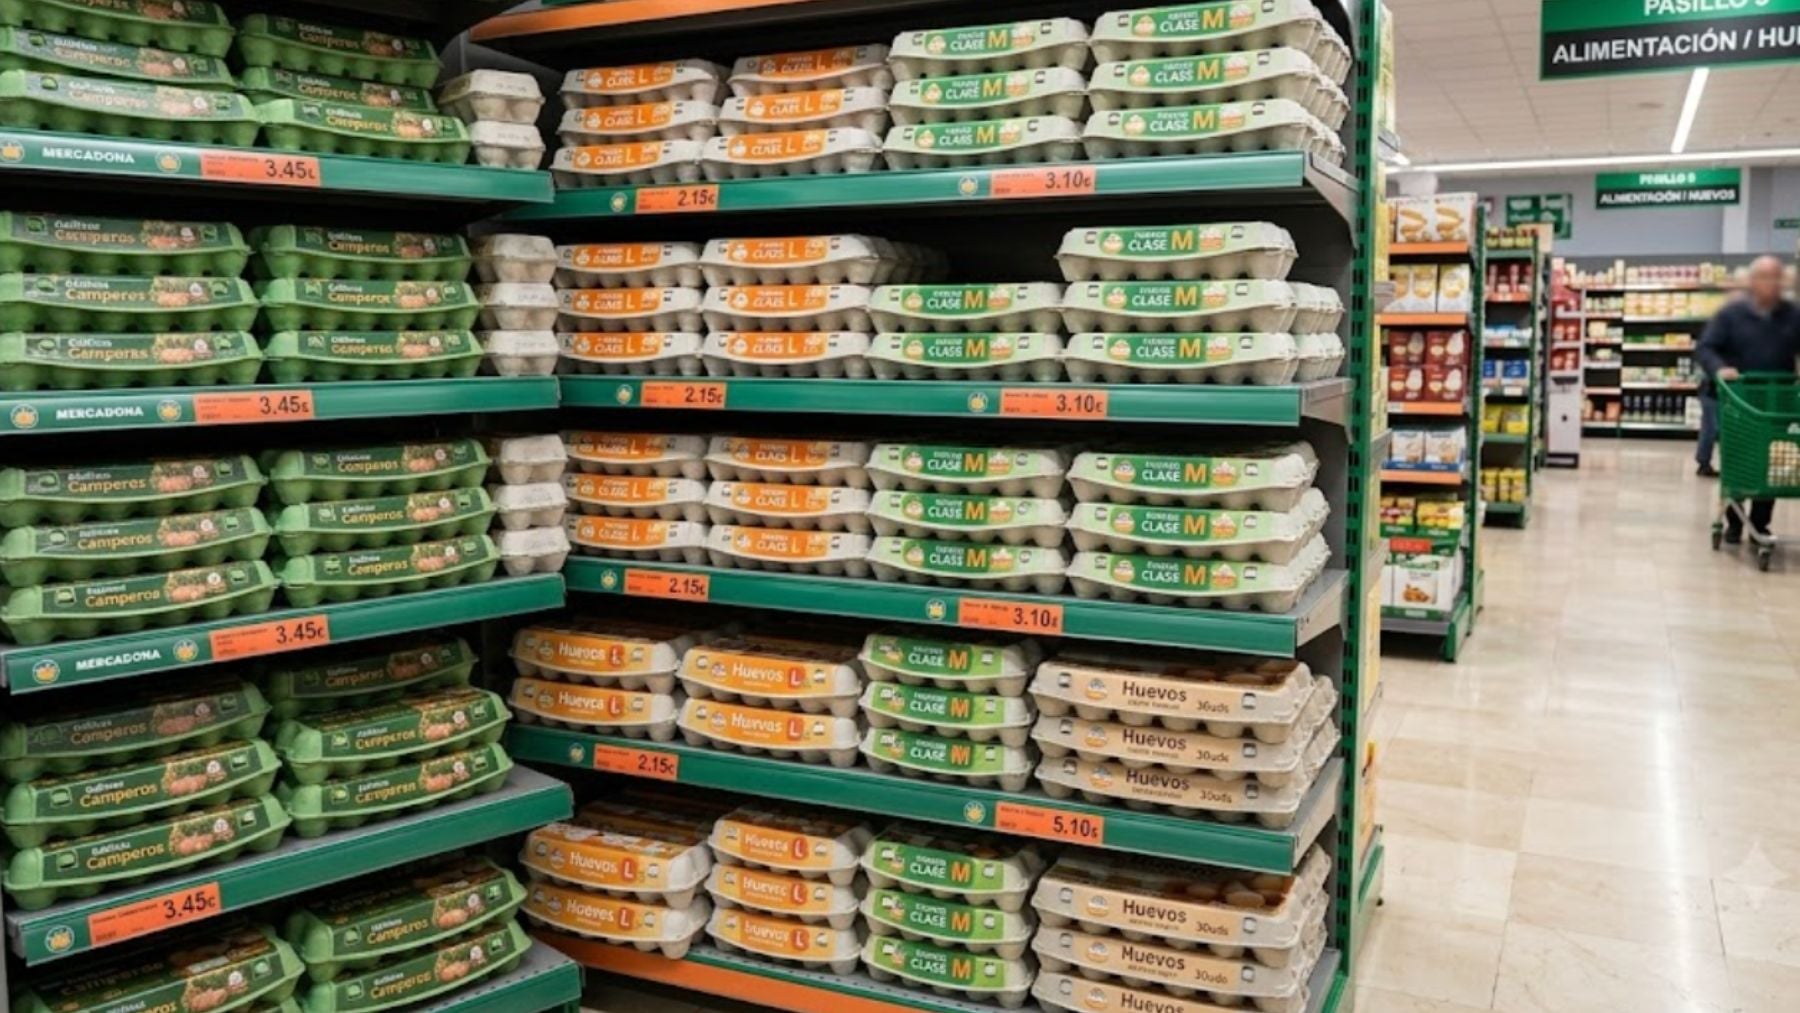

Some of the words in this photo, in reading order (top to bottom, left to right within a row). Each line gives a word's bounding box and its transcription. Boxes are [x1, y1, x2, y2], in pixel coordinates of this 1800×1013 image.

[1159, 18, 1200, 34] CLASE
[1202, 8, 1225, 29] M
[988, 30, 1009, 49] M
[1553, 28, 1738, 64] ALIMENTACIÓN
[1743, 29, 1753, 49] /
[817, 53, 826, 70] L
[1197, 59, 1220, 80] M
[639, 69, 649, 84] L
[982, 79, 1003, 97] M
[805, 97, 815, 113] L
[638, 108, 647, 124] L
[1193, 110, 1216, 130] M
[976, 126, 996, 144] M
[787, 138, 797, 153] L
[42, 147, 135, 165] MERCADONA
[626, 148, 636, 164] L
[789, 242, 798, 259] L
[1128, 237, 1168, 252] CLASE
[1171, 229, 1194, 250] M
[626, 294, 636, 309] L
[788, 289, 798, 307] L
[964, 290, 985, 309] M
[1131, 293, 1172, 306] CLASE
[1174, 286, 1198, 306] M
[626, 337, 636, 353] L
[788, 336, 798, 353] L
[966, 338, 986, 357] M
[1135, 345, 1176, 358] CLASE
[1179, 338, 1202, 358] M
[56, 405, 144, 421] MERCADONA
[790, 445, 800, 462] L
[964, 453, 985, 472] M
[1184, 463, 1207, 483] M
[791, 491, 800, 508] L
[965, 501, 985, 520] M
[1140, 519, 1180, 534] CLASE
[1183, 515, 1206, 535] M
[791, 536, 801, 553] L
[966, 549, 987, 567] M
[1141, 569, 1180, 583] CLASE
[1184, 564, 1207, 585] M
[76, 649, 162, 672] MERCADONA
[948, 649, 969, 670] M
[732, 663, 784, 683] Huevos
[1122, 680, 1188, 702] Huevos
[950, 697, 970, 719] M
[1122, 728, 1187, 751] Huevos
[951, 744, 970, 766] M
[1125, 768, 1190, 792] Huevos
[80, 781, 158, 809] Camperos
[87, 843, 165, 871] Camperos
[570, 851, 618, 874] Huevos
[951, 861, 970, 883] M
[1123, 899, 1188, 924] Huevos
[951, 911, 970, 933] M
[951, 958, 971, 980] M
[1121, 992, 1185, 1013] Huevos
